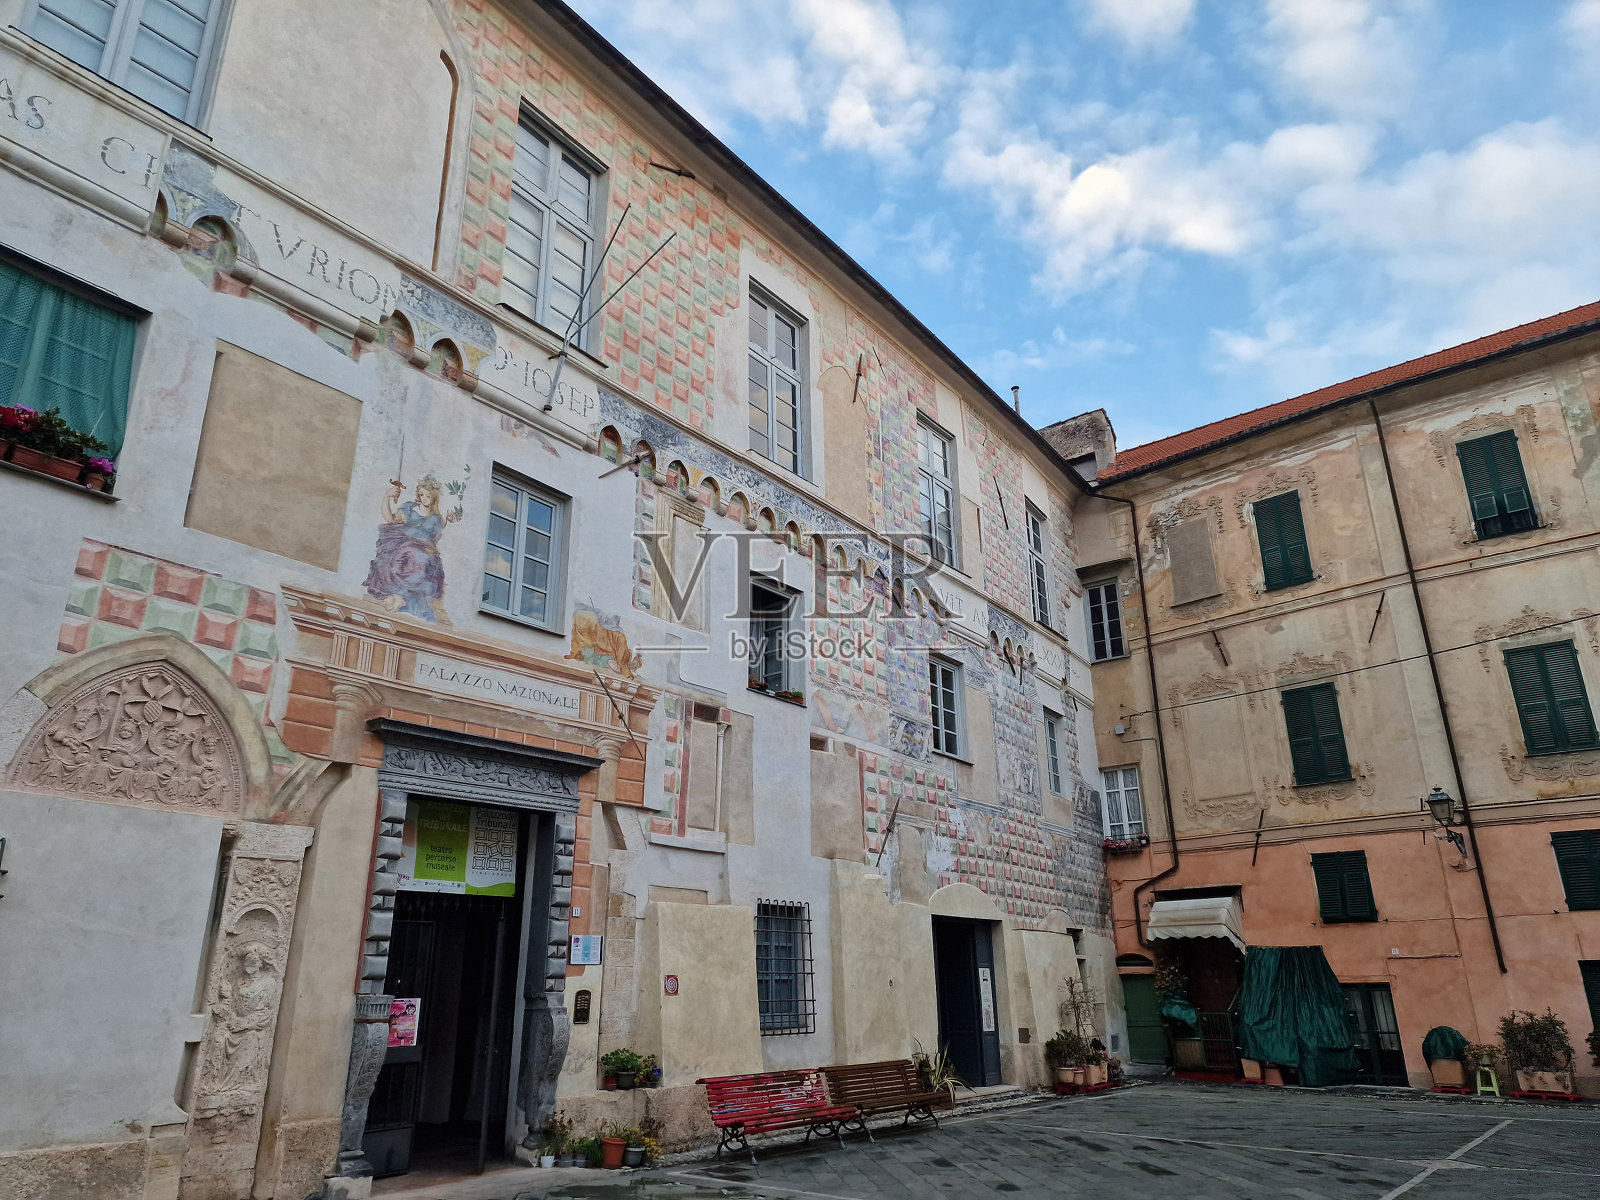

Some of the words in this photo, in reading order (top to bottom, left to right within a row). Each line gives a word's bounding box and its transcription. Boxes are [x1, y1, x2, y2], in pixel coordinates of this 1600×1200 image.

[419, 663, 493, 690] PALAZZO
[496, 681, 579, 710] NAZIONALE
[419, 819, 468, 833] TRIBUNALE
[477, 818, 517, 830] Tribunale
[430, 844, 453, 854] teatro
[425, 853, 457, 864] percorso
[426, 862, 456, 872] museale
